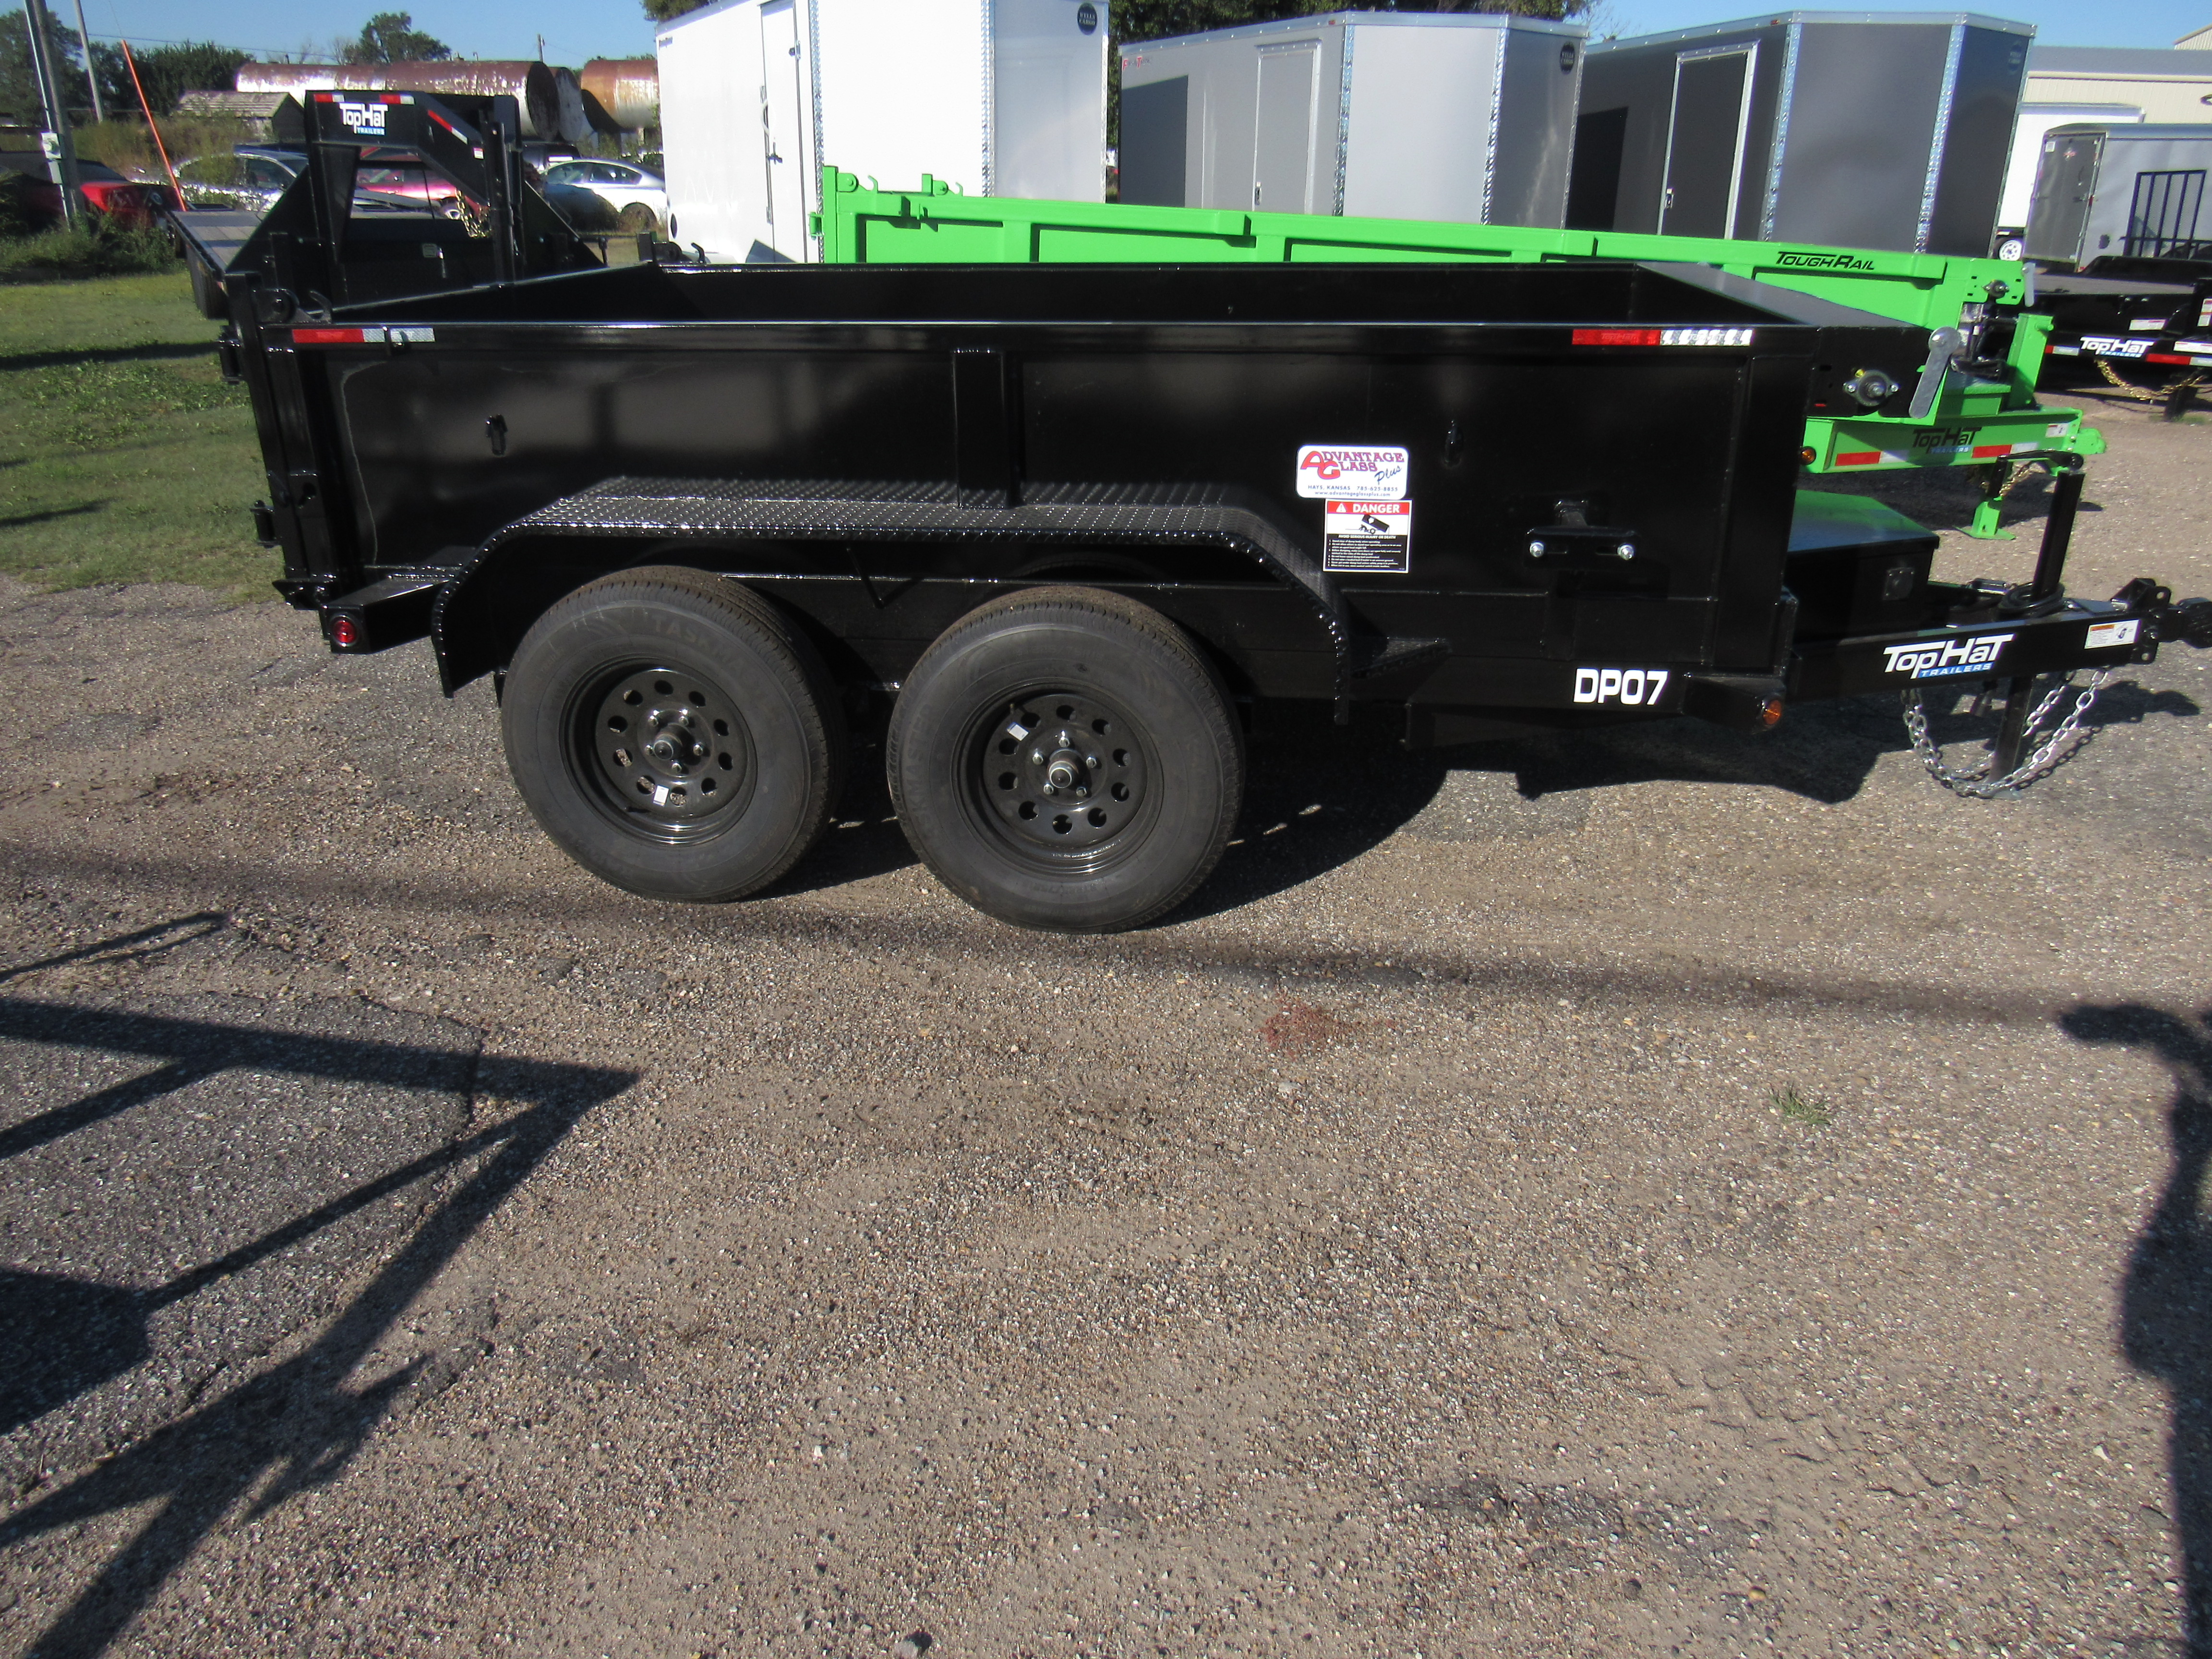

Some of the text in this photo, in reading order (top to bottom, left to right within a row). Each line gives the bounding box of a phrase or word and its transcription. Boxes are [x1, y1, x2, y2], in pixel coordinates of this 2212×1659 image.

[357, 127, 385, 135] TRAILERS
[1300, 450, 1405, 470] ADVANTAGE
[1317, 460, 1378, 480] GLASS
[1374, 465, 1402, 485] Plus
[1352, 504, 1400, 513] DANGER
[1921, 663, 1992, 678] TRAILERS
[1573, 668, 1669, 706] DP07
